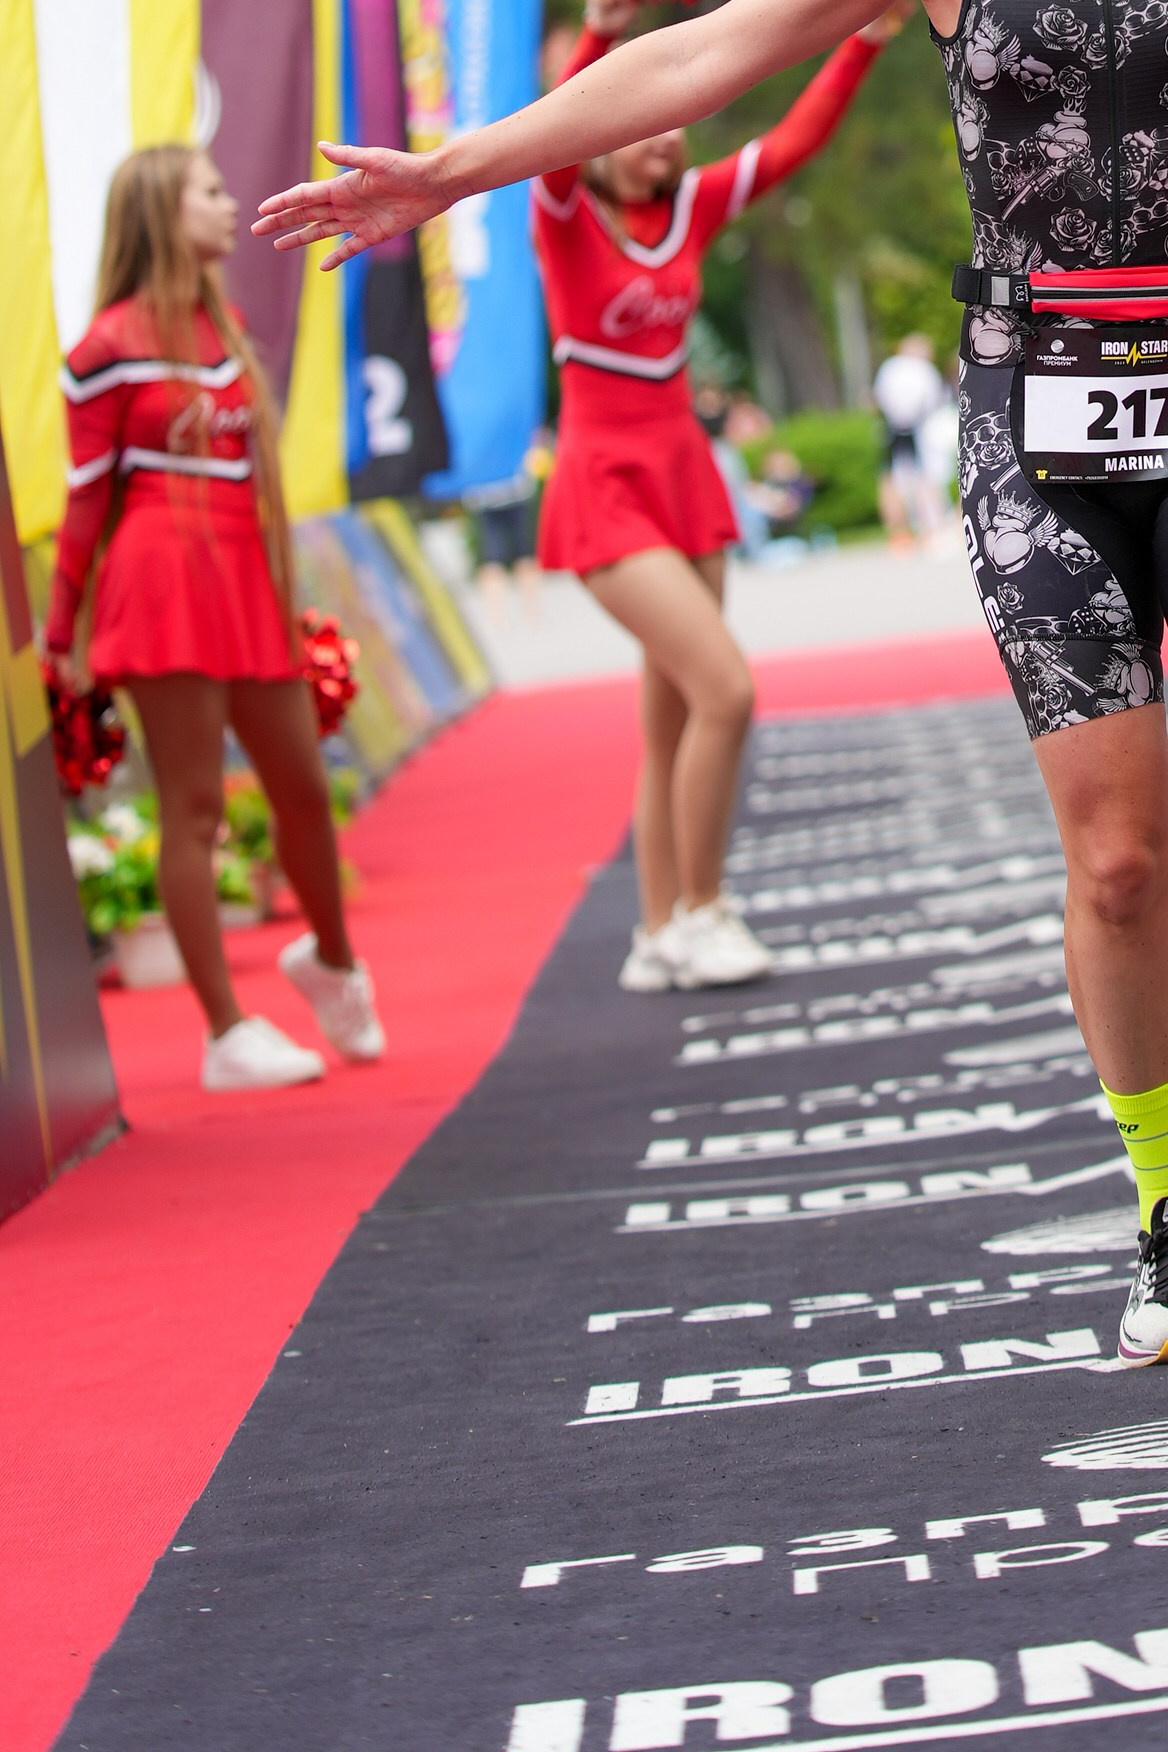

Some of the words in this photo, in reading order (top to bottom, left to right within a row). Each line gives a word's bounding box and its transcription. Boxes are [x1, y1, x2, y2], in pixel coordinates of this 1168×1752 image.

[1101, 341, 1129, 356] IRON
[1140, 339, 1168, 355] STAR
[1036, 354, 1078, 362] ГАЗПРОМБАНК
[1104, 455, 1165, 473] MARINA
[1113, 1119, 1139, 1134] ep
[582, 1327, 1103, 1415] IRON
